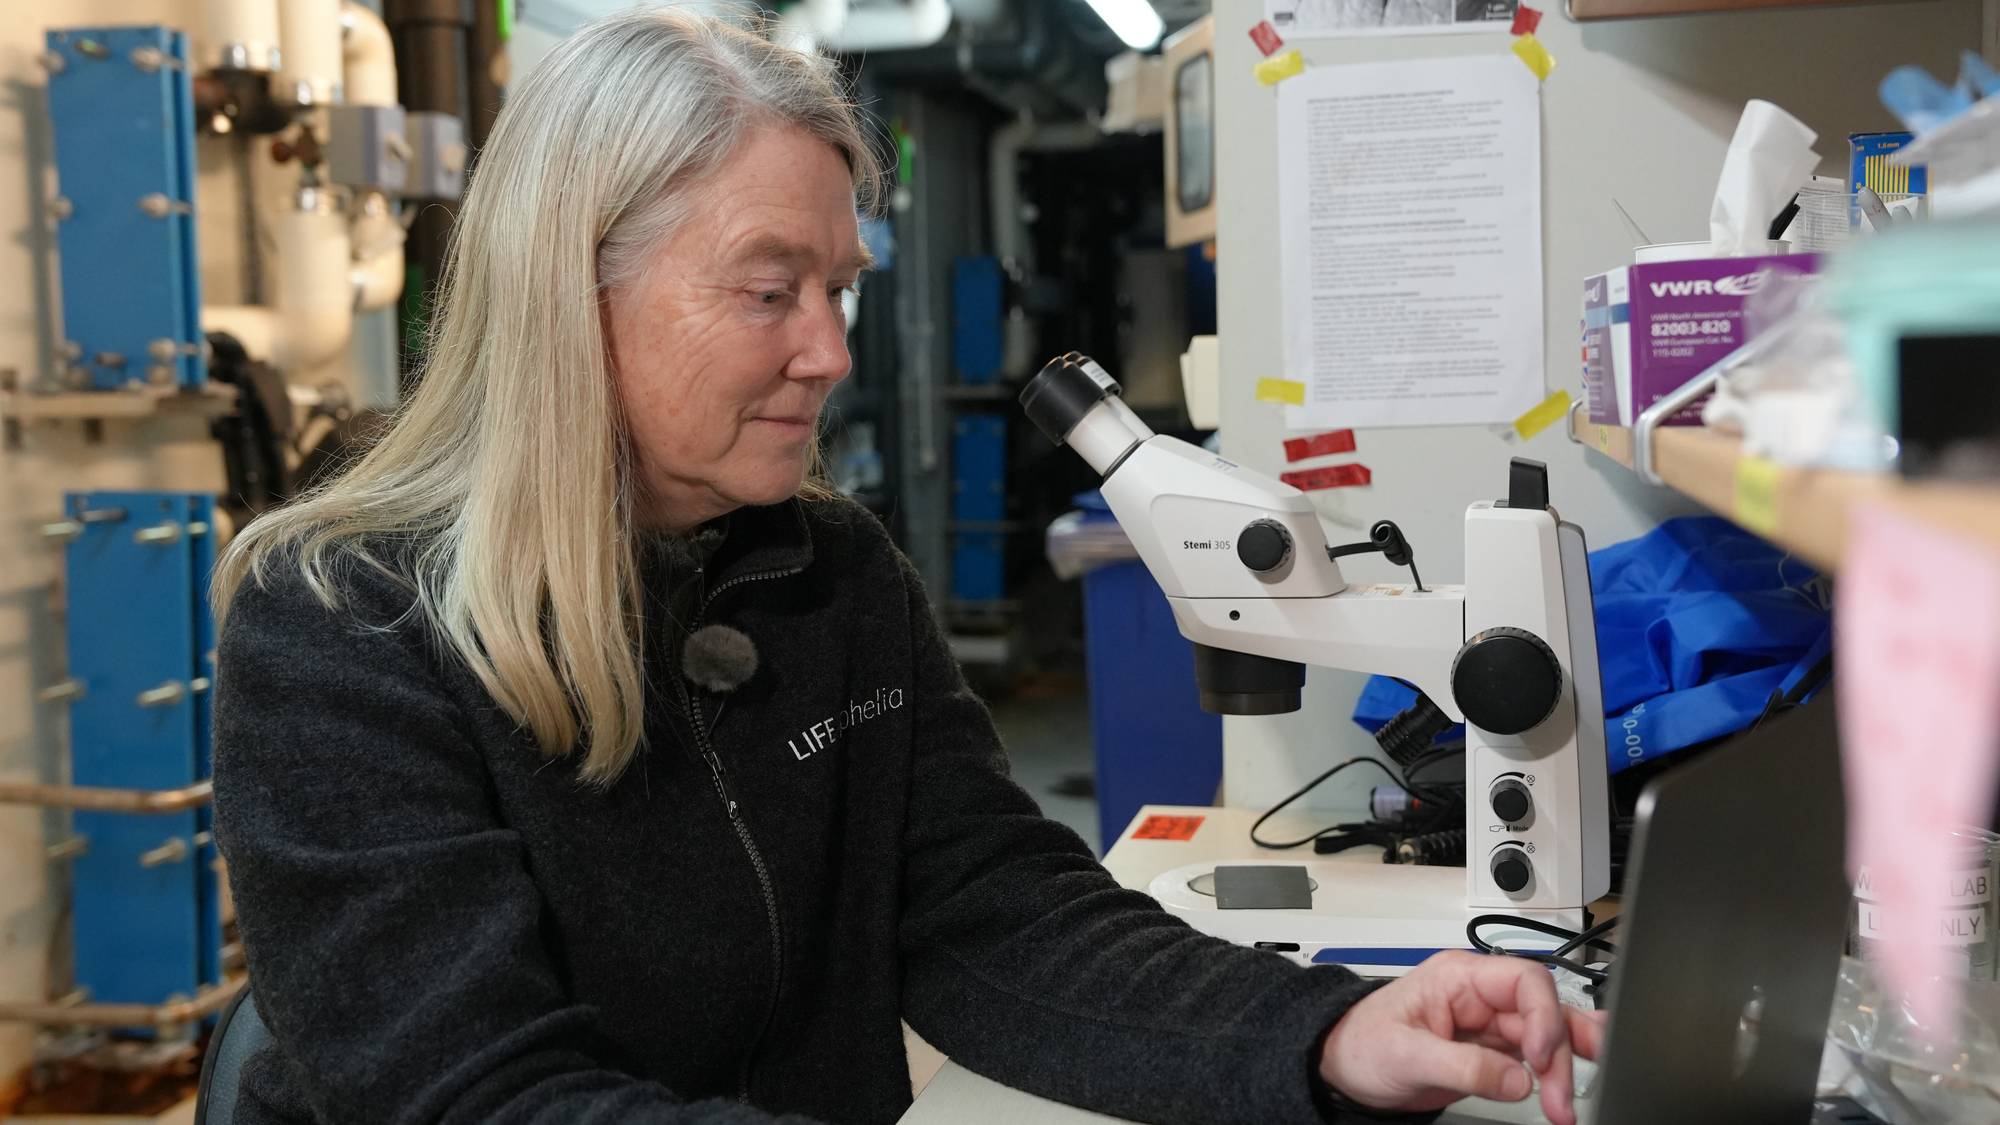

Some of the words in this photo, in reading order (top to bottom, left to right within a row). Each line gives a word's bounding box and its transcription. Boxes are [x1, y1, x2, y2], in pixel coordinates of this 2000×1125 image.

[1649, 280, 1713, 298] VWR
[1650, 319, 1731, 337] 82003-820
[1183, 540, 1211, 549] Stemi
[1214, 540, 1231, 550] 305
[787, 687, 903, 761] LIFEphelia
[1951, 876, 1988, 897] LAB
[1940, 915, 1981, 937] NLY
